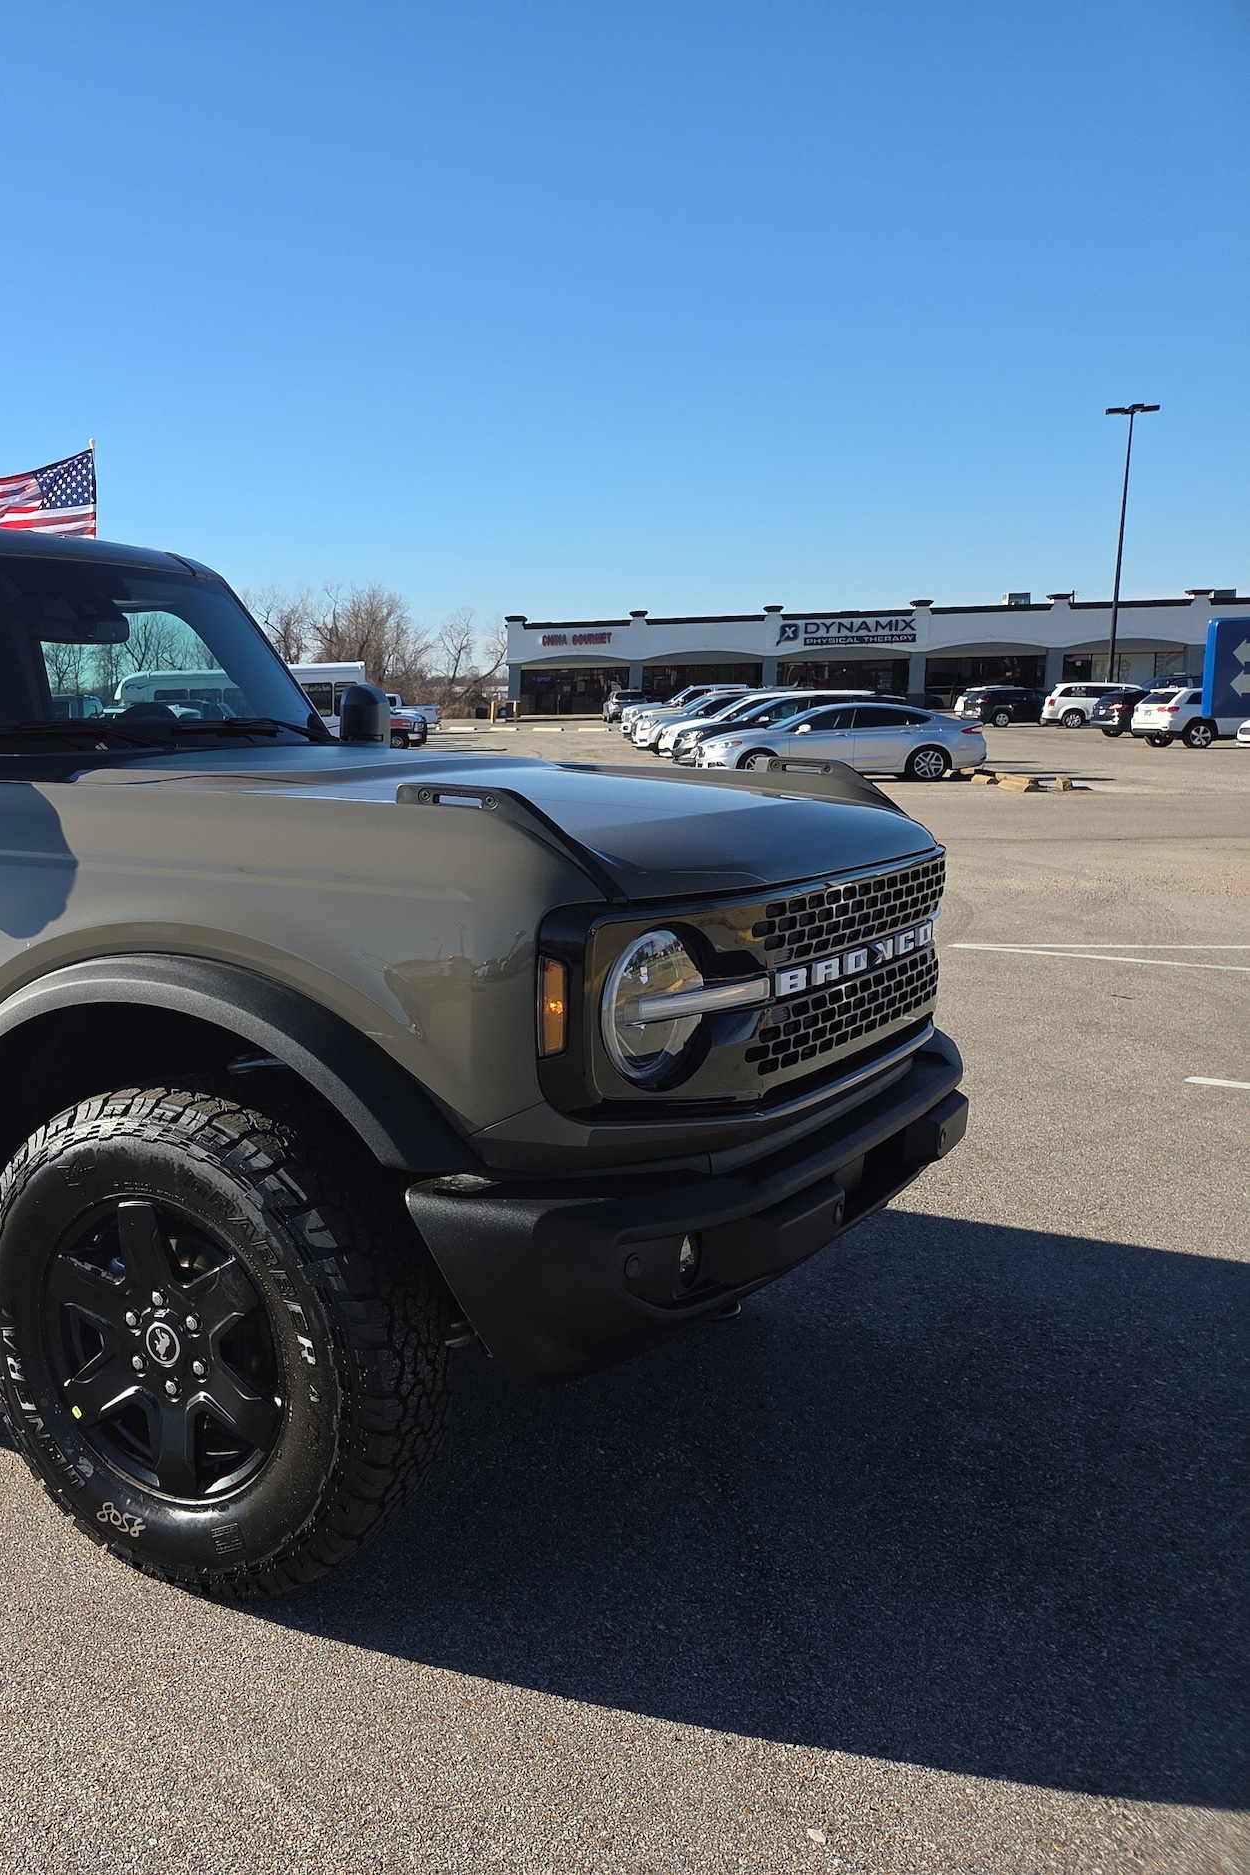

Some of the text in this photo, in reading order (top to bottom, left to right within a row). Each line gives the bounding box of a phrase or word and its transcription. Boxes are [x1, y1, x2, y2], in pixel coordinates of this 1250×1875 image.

[804, 618, 916, 634] DYNAMIX
[542, 632, 613, 647] CHINA GOURMET
[805, 635, 914, 645] PHYSICAL THERAPY
[775, 920, 934, 997] BRONCO
[96, 1501, 147, 1538] 8058
